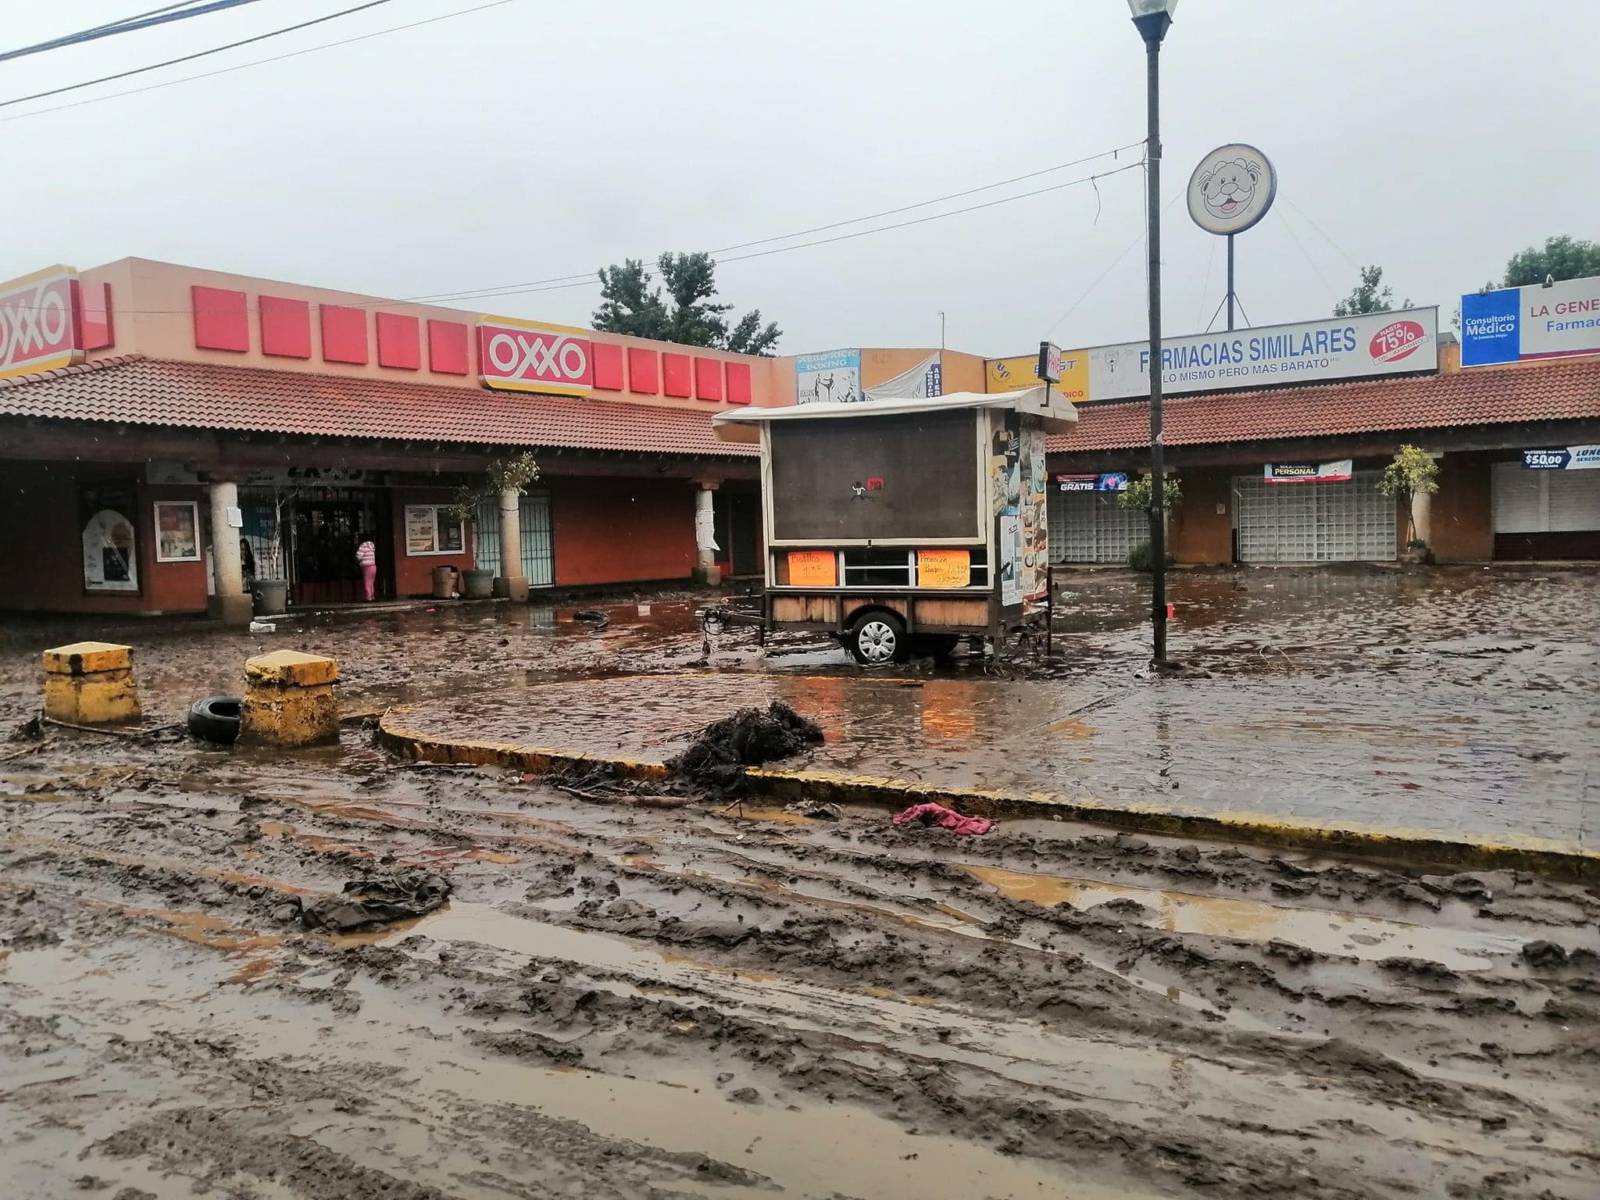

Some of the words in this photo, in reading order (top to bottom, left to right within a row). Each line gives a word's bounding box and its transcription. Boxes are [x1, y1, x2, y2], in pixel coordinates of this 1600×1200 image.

[1465, 313, 1515, 326] Consultorio
[1531, 305, 1549, 318] LA
[1466, 322, 1514, 336] Médico
[1376, 326, 1415, 353] 75%
[489, 333, 586, 379] OXXO
[1140, 340, 1243, 373] FRMACIAS
[1250, 327, 1357, 361] SIMILARES
[1163, 373, 1176, 384] LO
[1180, 369, 1216, 382] MISMO
[1219, 367, 1249, 378] PERO
[1253, 363, 1277, 374] MAS
[1060, 482, 1095, 491] GRATIS
